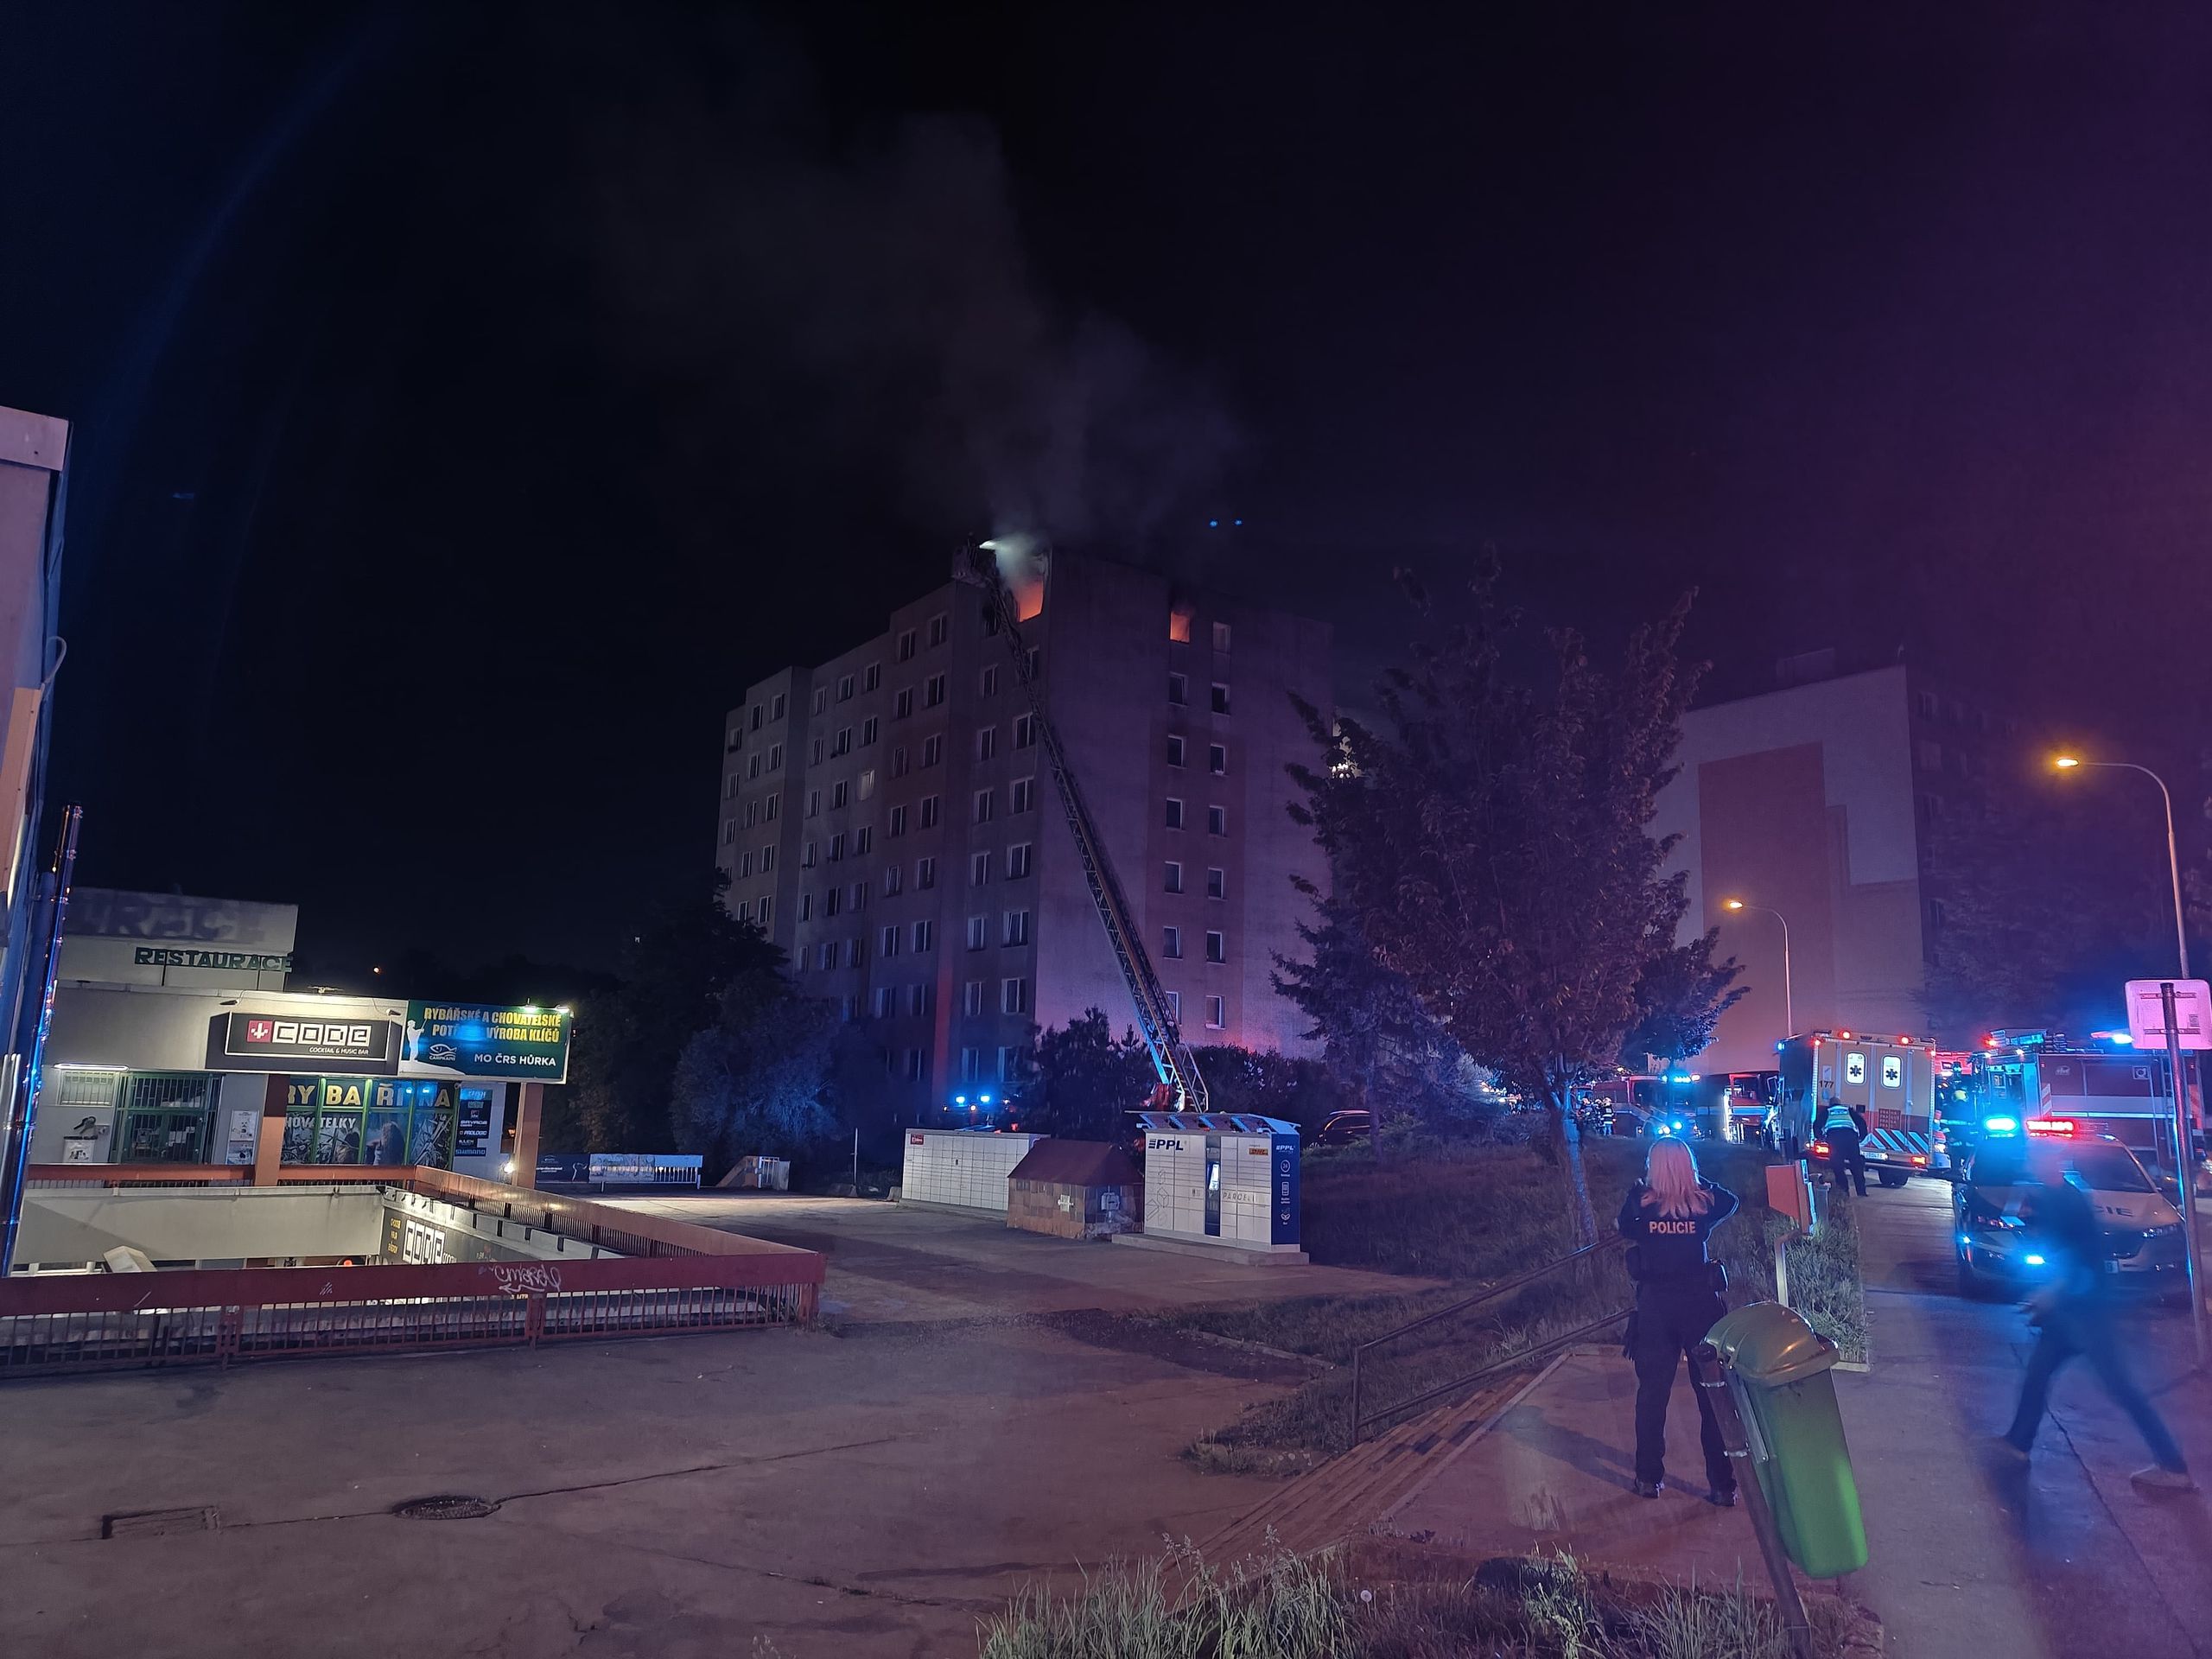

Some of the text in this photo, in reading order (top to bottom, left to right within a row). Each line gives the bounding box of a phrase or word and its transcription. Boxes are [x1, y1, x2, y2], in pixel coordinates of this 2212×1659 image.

[135, 947, 293, 973] RESTAURACE
[424, 1007, 562, 1027] RYBÁŘSKÉ A CHOVATELSKÉ
[274, 1023, 370, 1046] CODE
[486, 1026, 527, 1041] VÝROBA
[529, 1027, 560, 1042] KLÍČŮ
[474, 1052, 556, 1066] MO ČRS HŮRKA
[1818, 1080, 1834, 1089] 177
[1649, 1221, 1696, 1234] POLICIE
